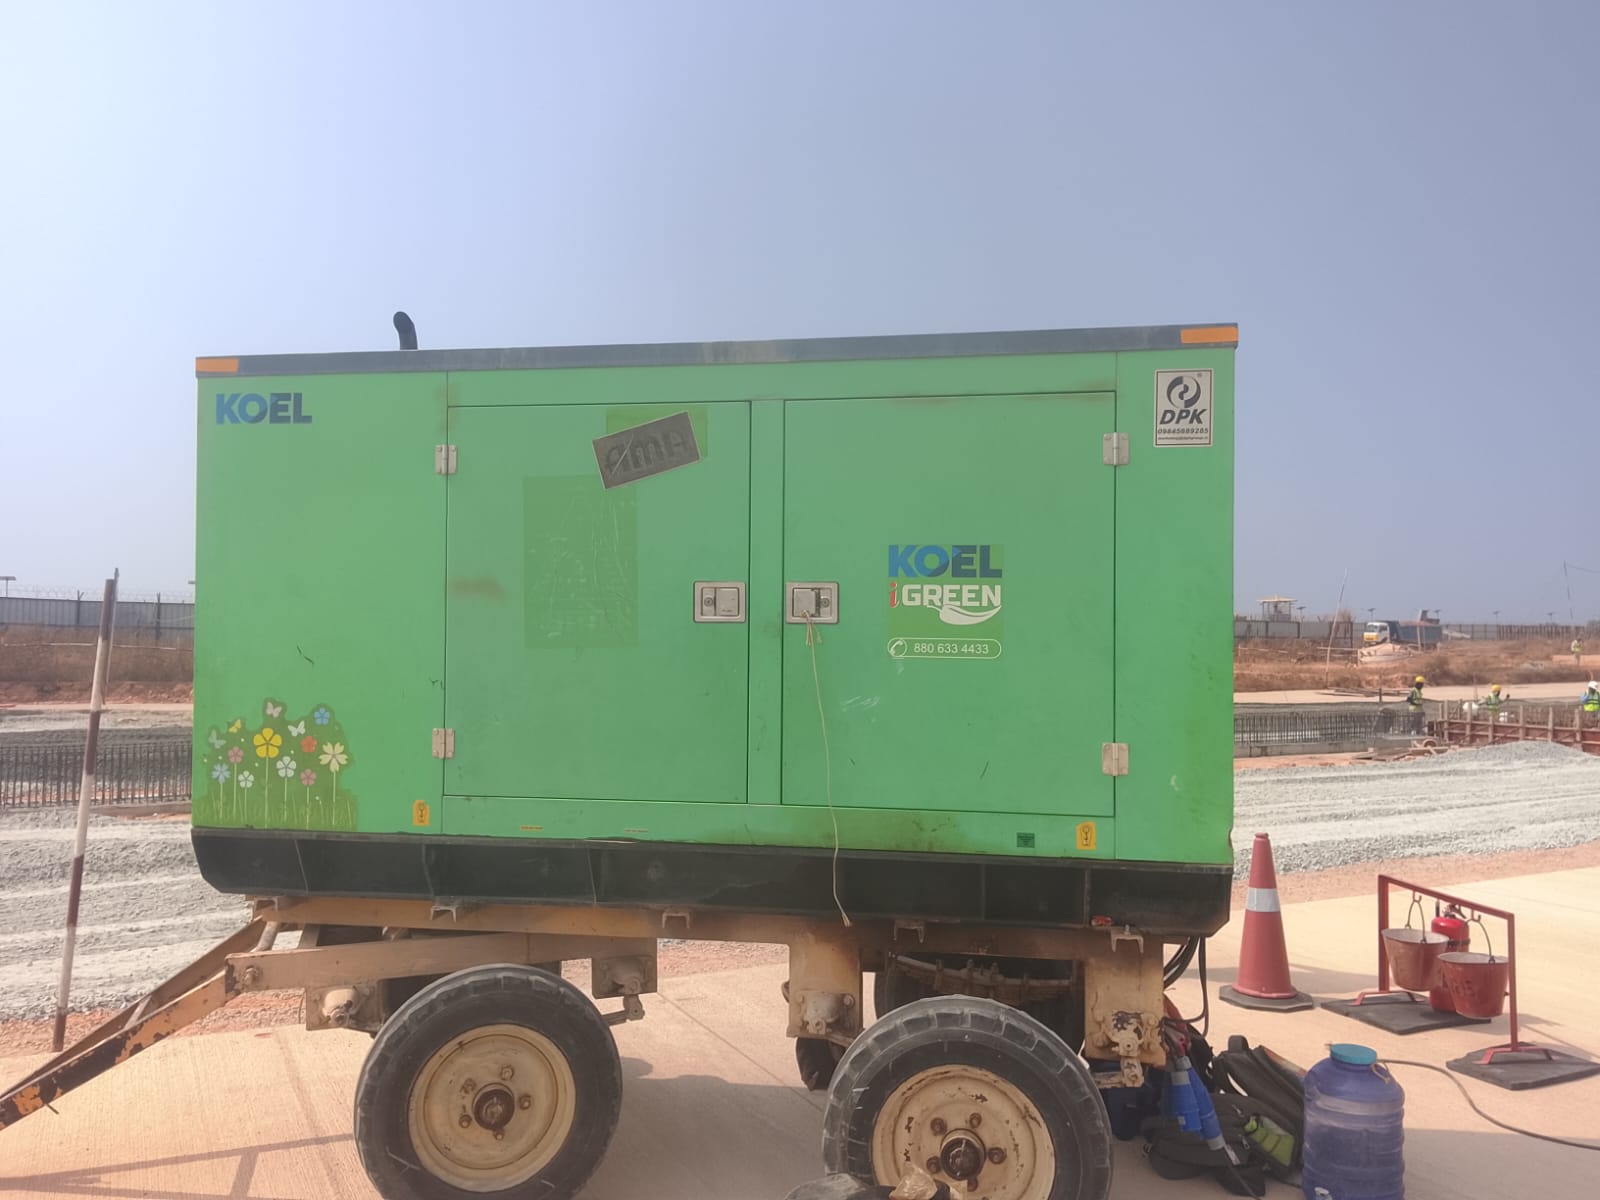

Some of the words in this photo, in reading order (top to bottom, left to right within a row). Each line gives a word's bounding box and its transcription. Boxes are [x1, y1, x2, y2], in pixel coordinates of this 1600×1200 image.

[216, 392, 312, 424] KOEL
[1159, 408, 1207, 425] DPK
[888, 545, 1003, 578] KOEL
[901, 583, 1002, 607] GREEN
[913, 643, 935, 654] 880
[937, 643, 958, 654] 633
[960, 643, 990, 654] 4433
